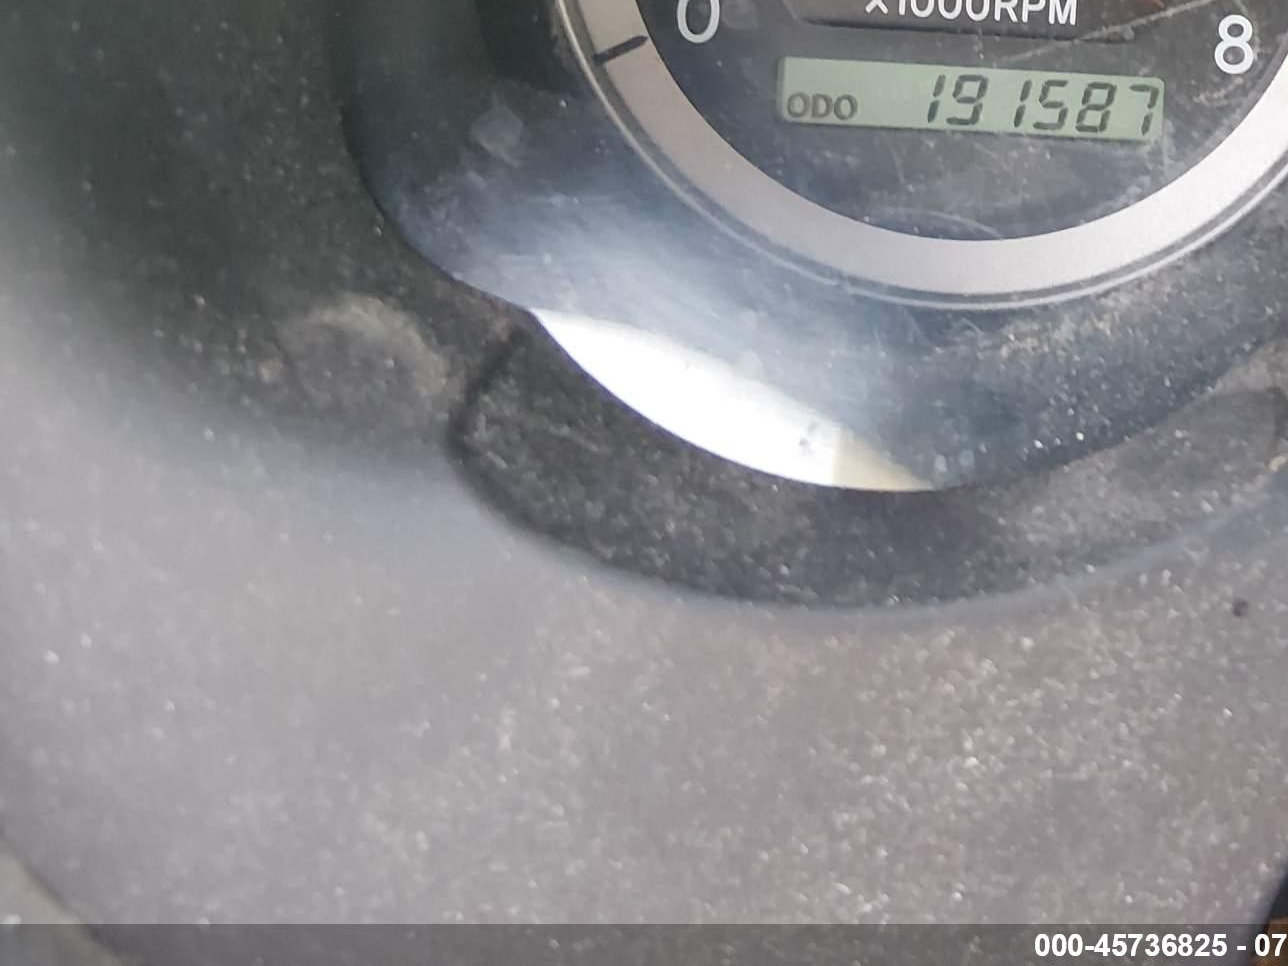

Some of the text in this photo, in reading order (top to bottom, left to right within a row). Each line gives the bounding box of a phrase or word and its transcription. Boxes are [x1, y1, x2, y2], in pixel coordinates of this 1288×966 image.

[1215, 15, 1255, 75] 8
[786, 72, 1161, 138] ODO 191587
